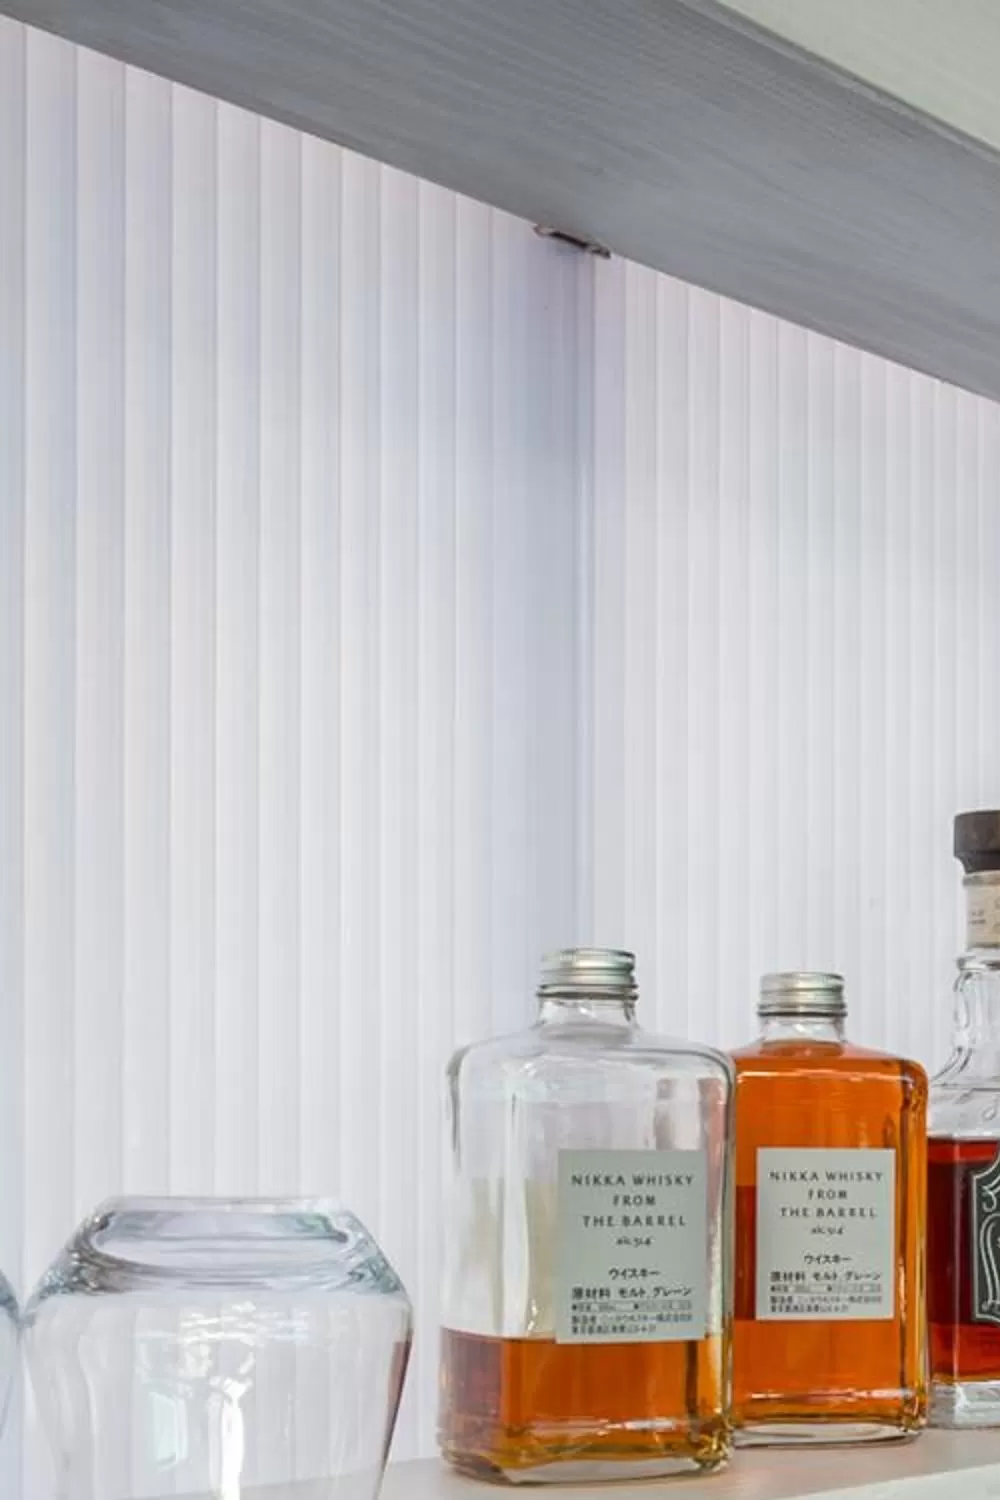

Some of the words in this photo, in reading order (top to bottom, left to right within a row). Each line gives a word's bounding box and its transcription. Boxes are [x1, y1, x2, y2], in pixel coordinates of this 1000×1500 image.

[571, 1174, 626, 1187] NIKKA
[631, 1173, 695, 1187] WHISKY
[769, 1171, 820, 1182] NIKKA
[825, 1170, 884, 1182] WHISKY
[612, 1194, 656, 1207] FROM
[807, 1189, 848, 1201] FROM
[780, 1207, 810, 1218] THE
[816, 1207, 878, 1218] BARREL
[582, 1215, 615, 1229] THE
[621, 1215, 688, 1228] BARREL
